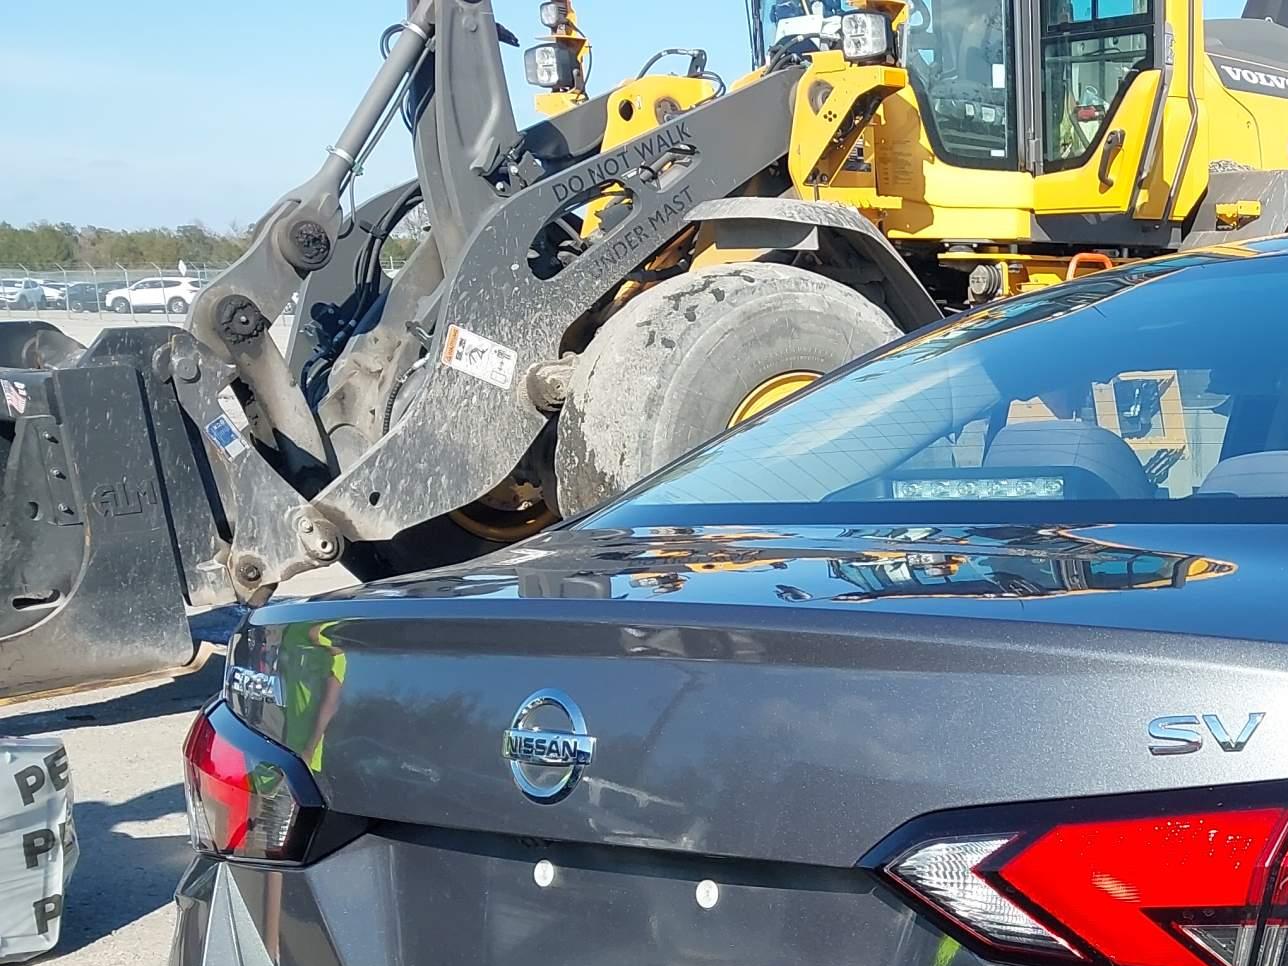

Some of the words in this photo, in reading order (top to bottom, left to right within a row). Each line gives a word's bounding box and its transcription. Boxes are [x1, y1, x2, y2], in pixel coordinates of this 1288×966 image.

[552, 175, 584, 202] DO
[588, 151, 630, 185] NOT
[634, 122, 692, 162] WALK
[648, 185, 694, 231] MAST
[506, 735, 578, 758] NISSAN
[1148, 712, 1266, 756] SV
